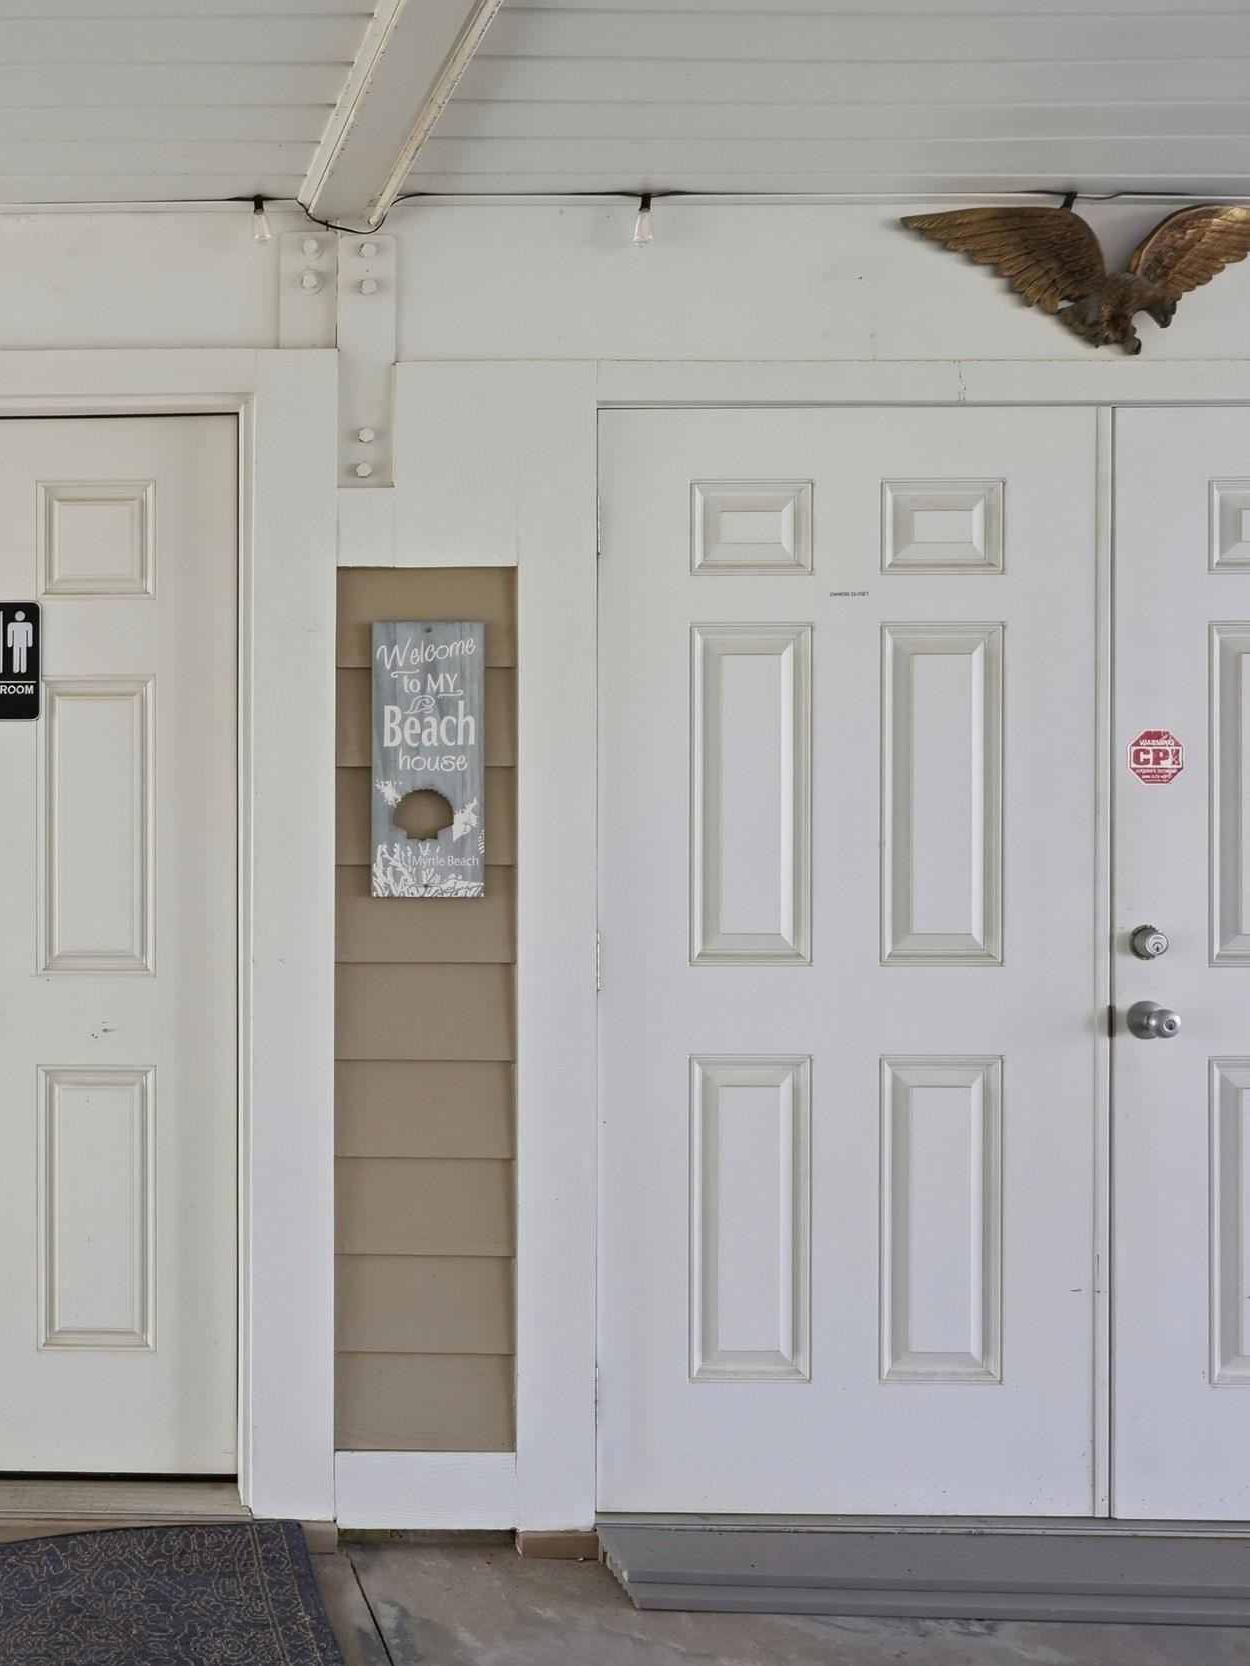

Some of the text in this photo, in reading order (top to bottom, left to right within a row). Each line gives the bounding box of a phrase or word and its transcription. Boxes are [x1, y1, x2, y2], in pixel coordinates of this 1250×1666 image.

[376, 637, 476, 669] Welcome
[402, 673, 458, 693] to MY
[382, 700, 476, 747] Beach
[398, 749, 468, 772] house
[1132, 748, 1181, 766] CPI
[412, 855, 479, 868] Myrtle Beach
